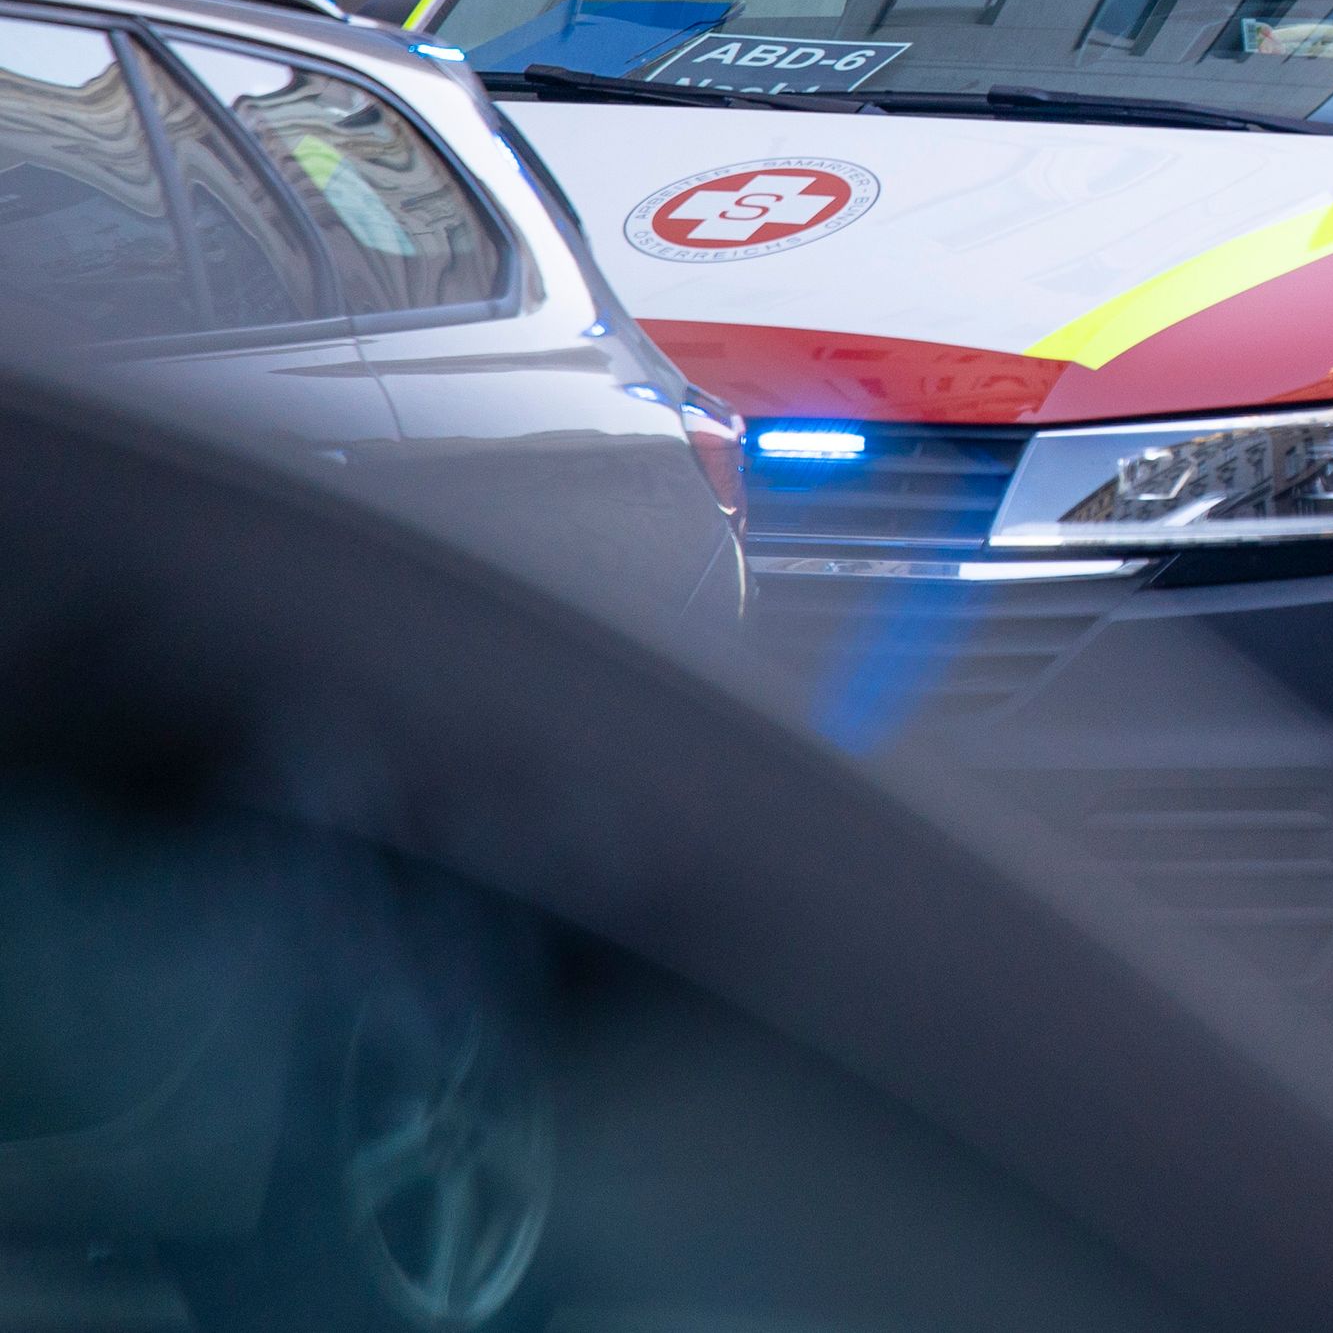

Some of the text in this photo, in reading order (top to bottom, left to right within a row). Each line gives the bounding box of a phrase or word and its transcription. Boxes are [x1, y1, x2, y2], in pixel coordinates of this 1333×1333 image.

[692, 42, 876, 71] ABD-6
[718, 193, 783, 221] S
[824, 196, 871, 230] BUND
